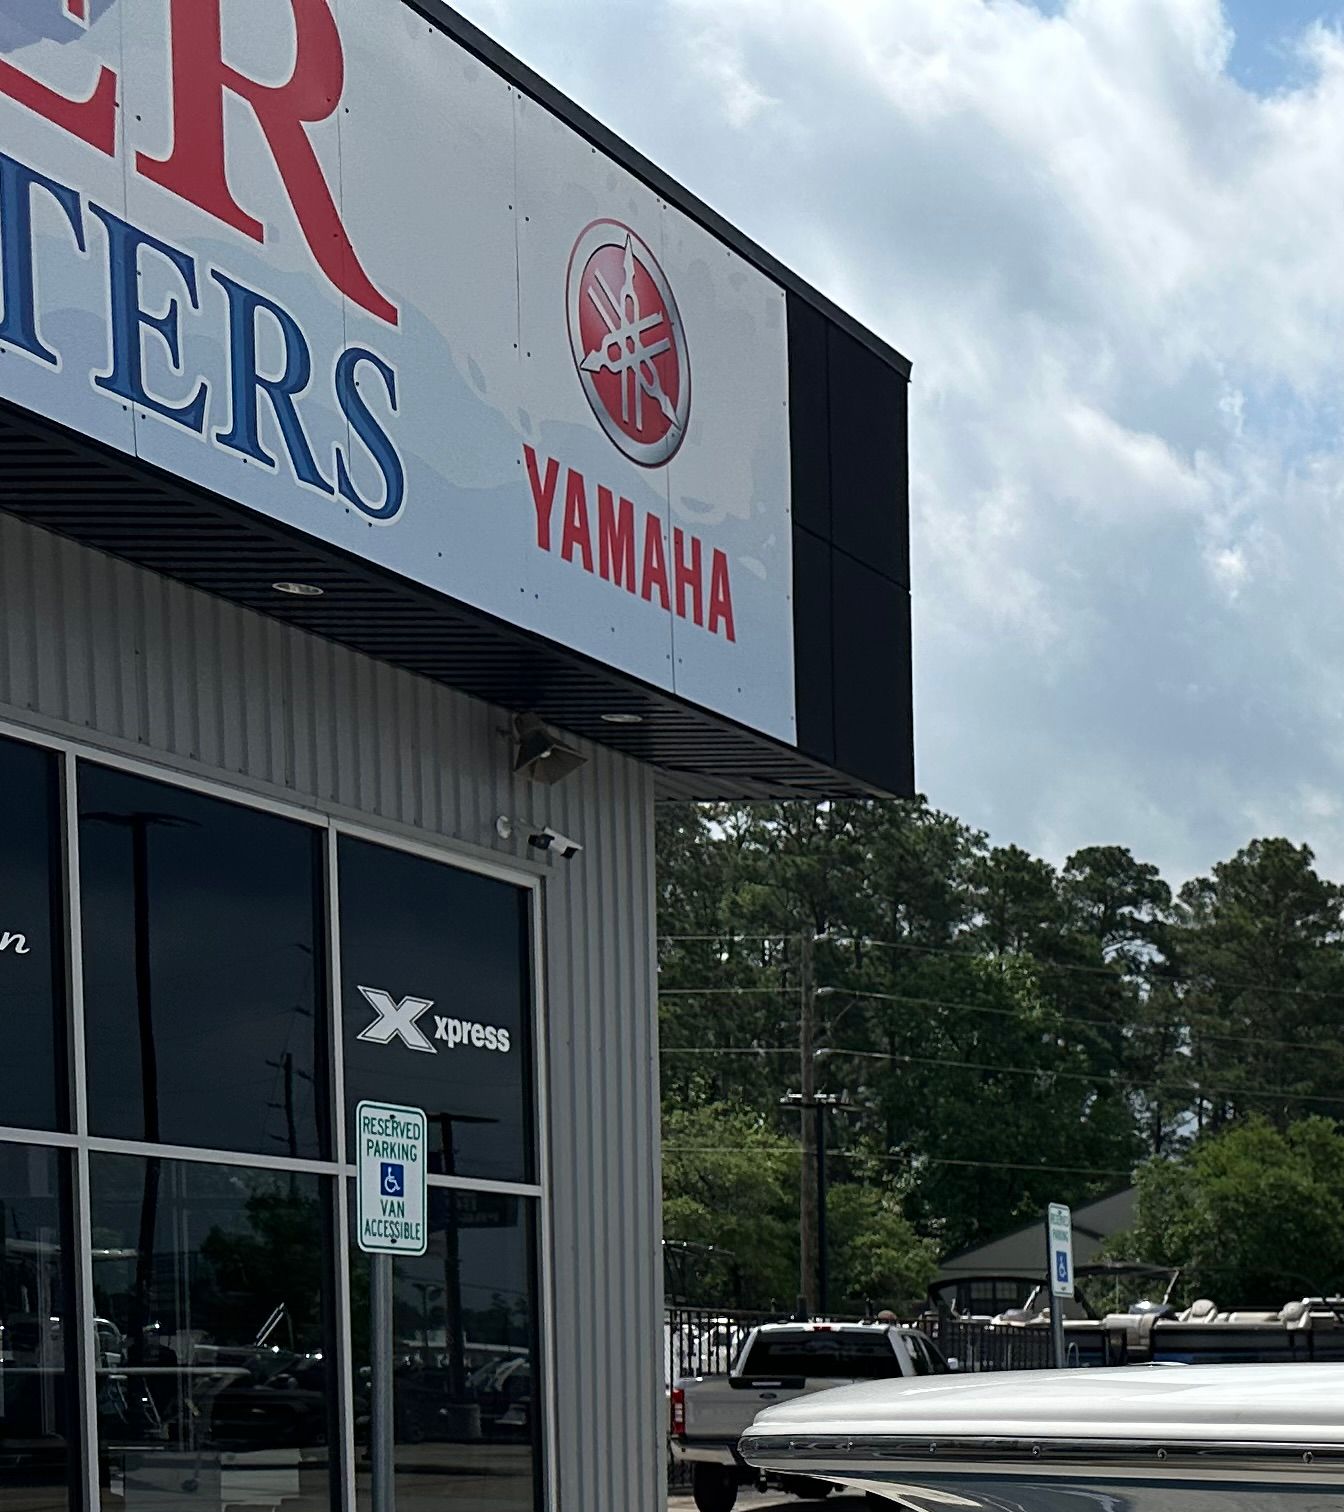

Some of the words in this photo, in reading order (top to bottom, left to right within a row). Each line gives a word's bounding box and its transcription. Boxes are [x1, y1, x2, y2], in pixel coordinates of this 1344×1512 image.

[0, 153, 404, 520] TERS
[523, 443, 736, 643] YAMAHA
[434, 1015, 510, 1052] xpress
[363, 1116, 421, 1140] RESERVED
[367, 1139, 417, 1162] PARKING
[381, 1199, 405, 1218] VAN
[364, 1218, 421, 1240] ACCESSIBLE
